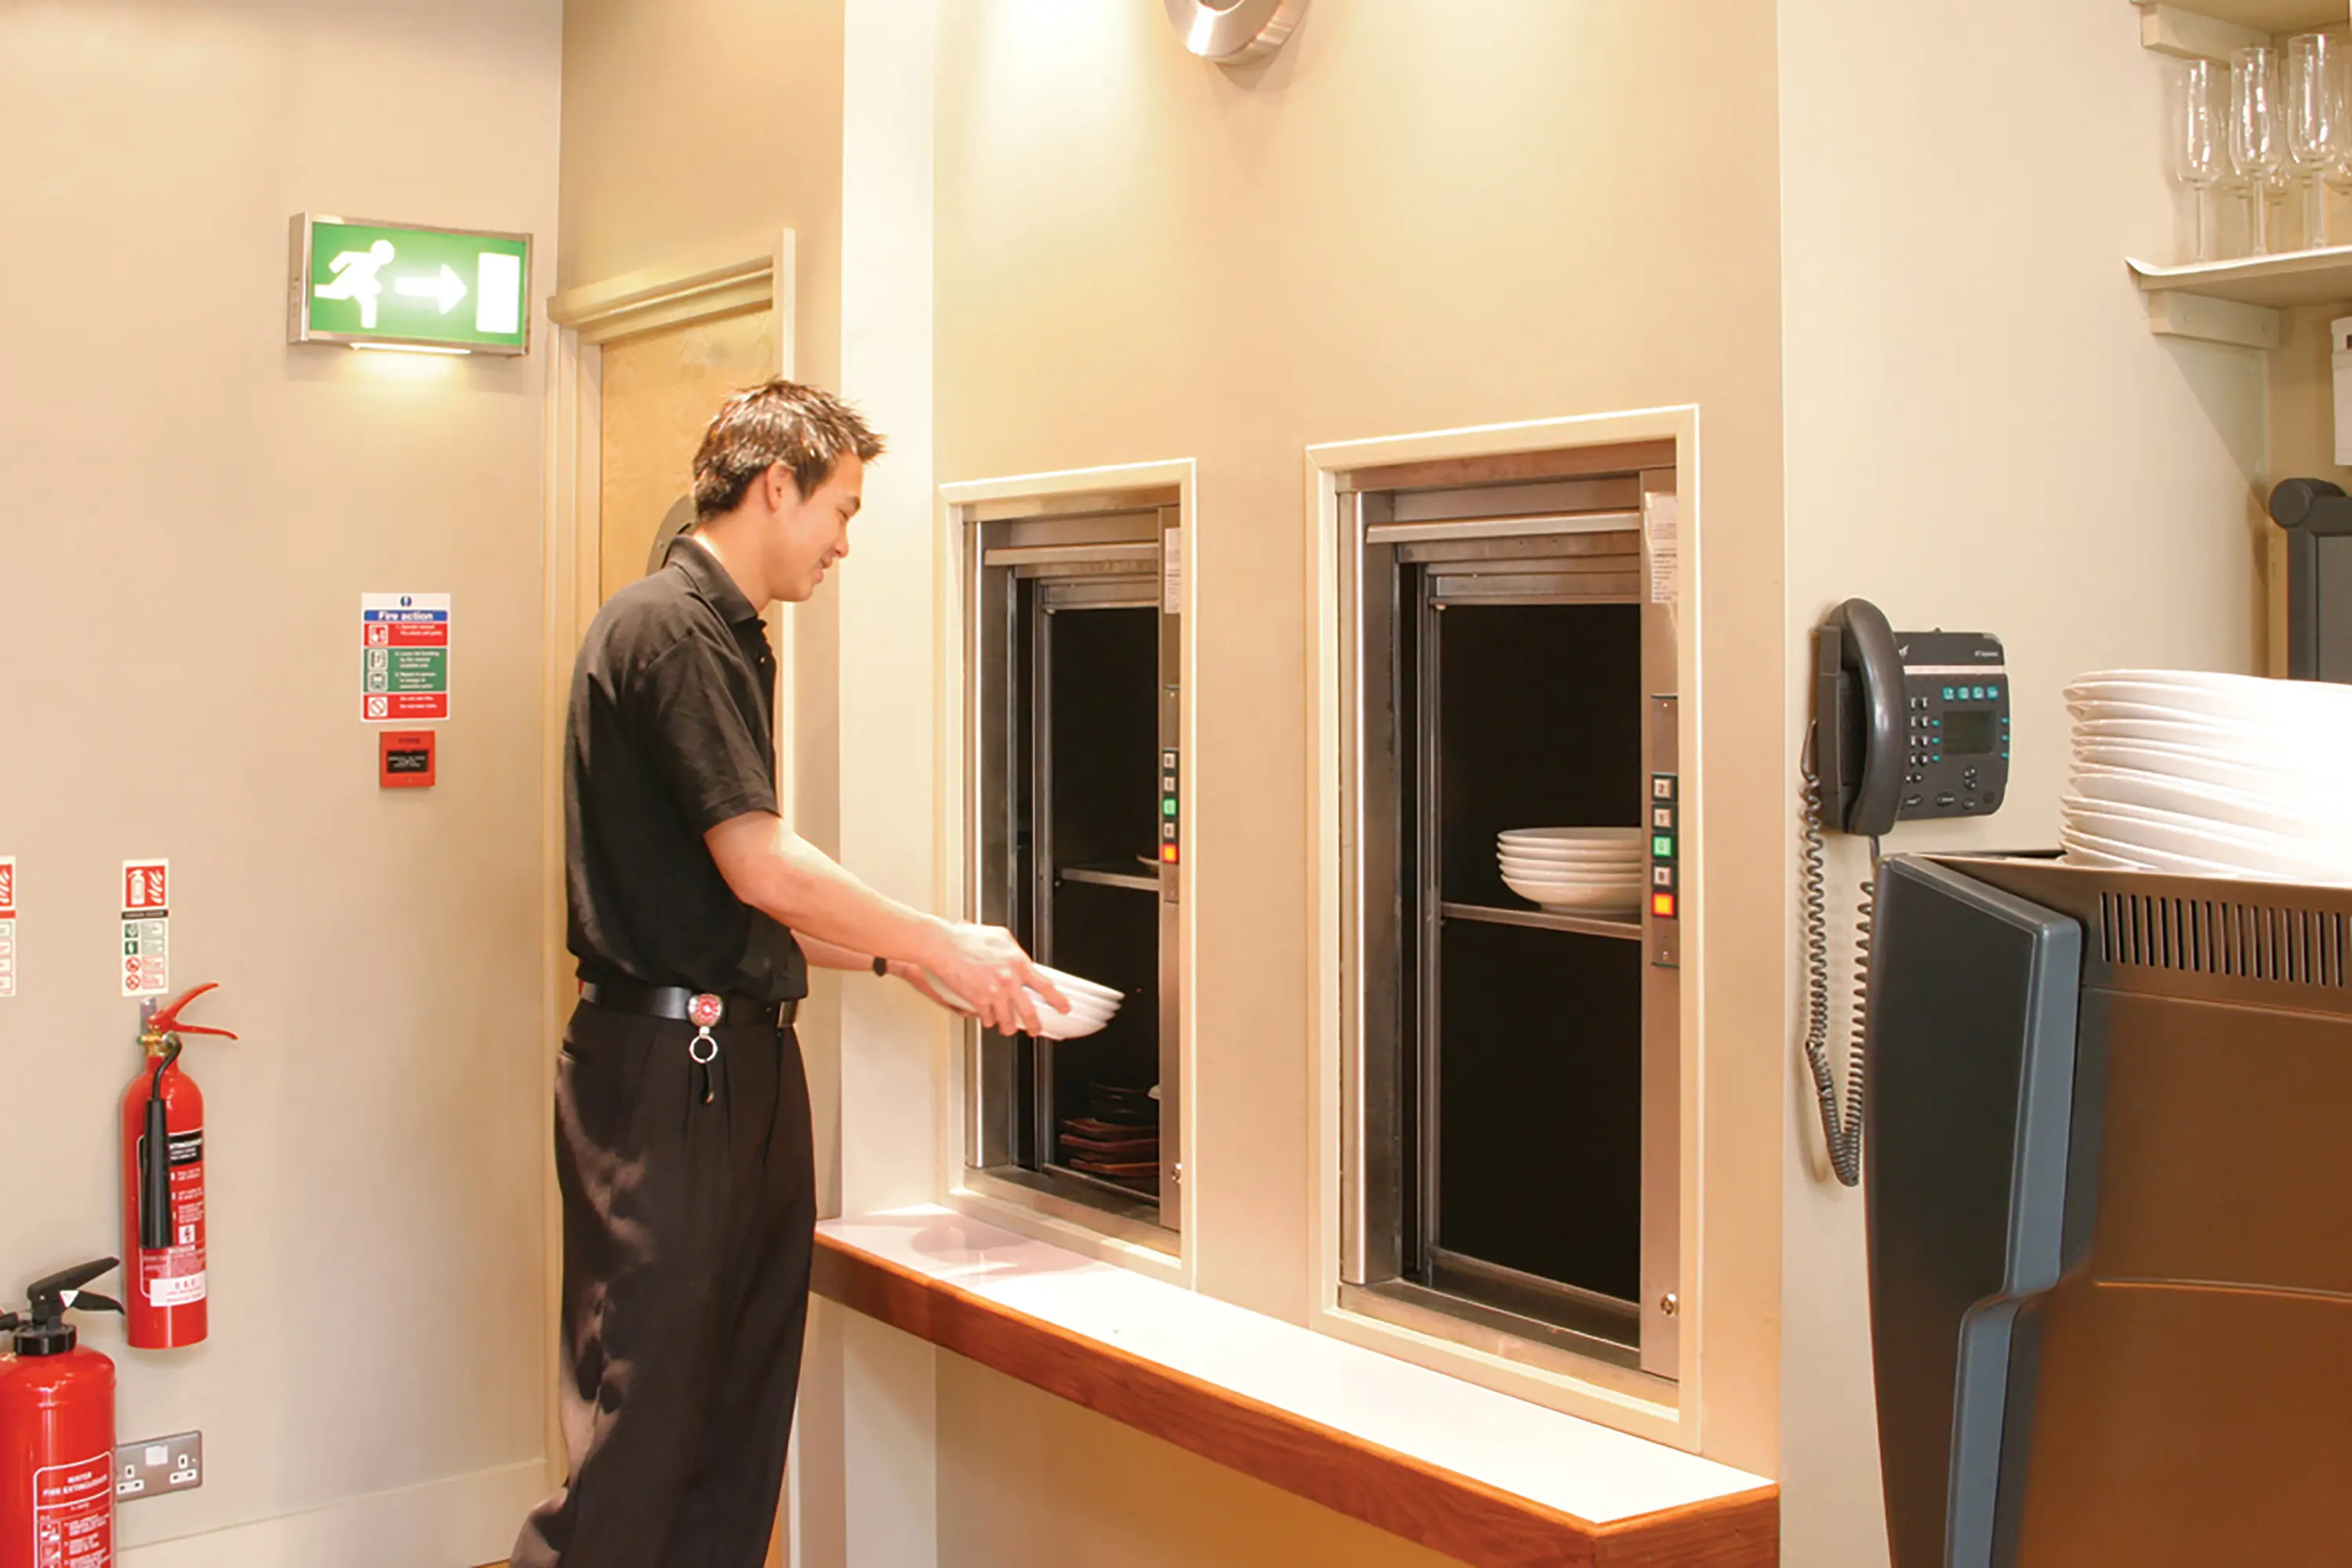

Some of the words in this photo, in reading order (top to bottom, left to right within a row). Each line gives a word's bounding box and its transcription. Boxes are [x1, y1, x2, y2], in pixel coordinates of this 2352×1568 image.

[379, 611, 398, 621] Fire
[401, 612, 434, 621] action
[1657, 782, 1664, 795] 2
[42, 1487, 61, 1497] FIRE
